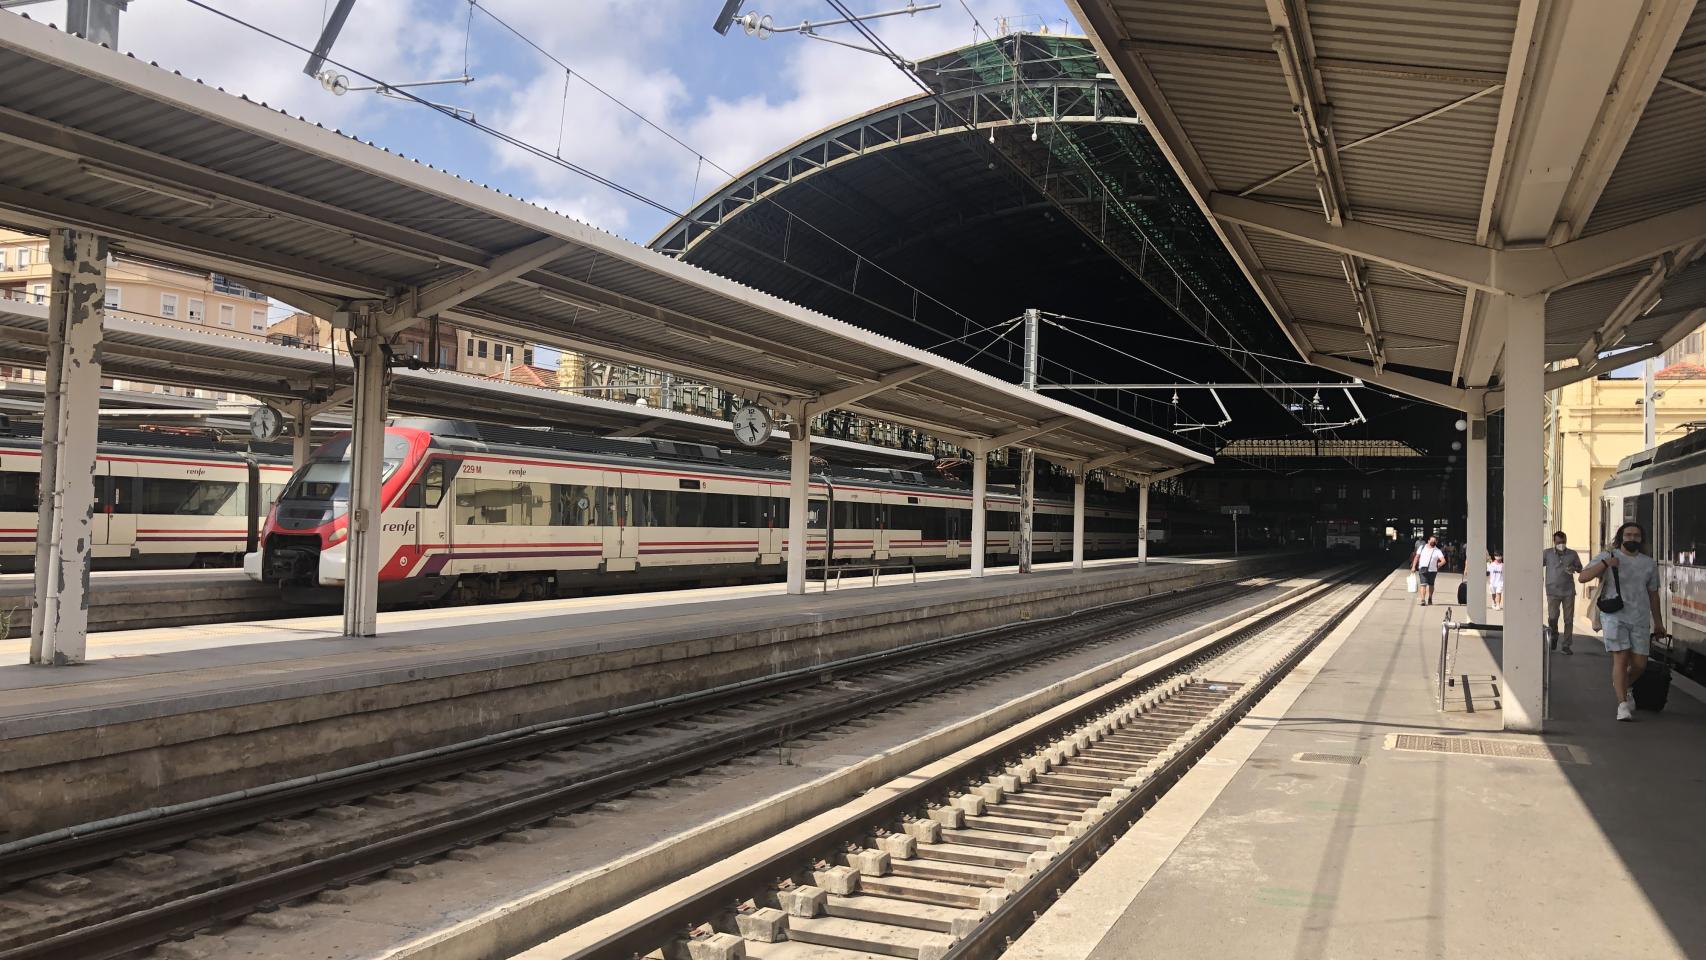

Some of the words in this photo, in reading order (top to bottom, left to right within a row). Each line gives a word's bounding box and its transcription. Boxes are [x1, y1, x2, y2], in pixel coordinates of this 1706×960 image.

[186, 468, 206, 476] renfe
[462, 465, 475, 474] 229
[476, 465, 482, 474] M
[508, 467, 527, 477] renfe
[382, 519, 416, 537] renfe
